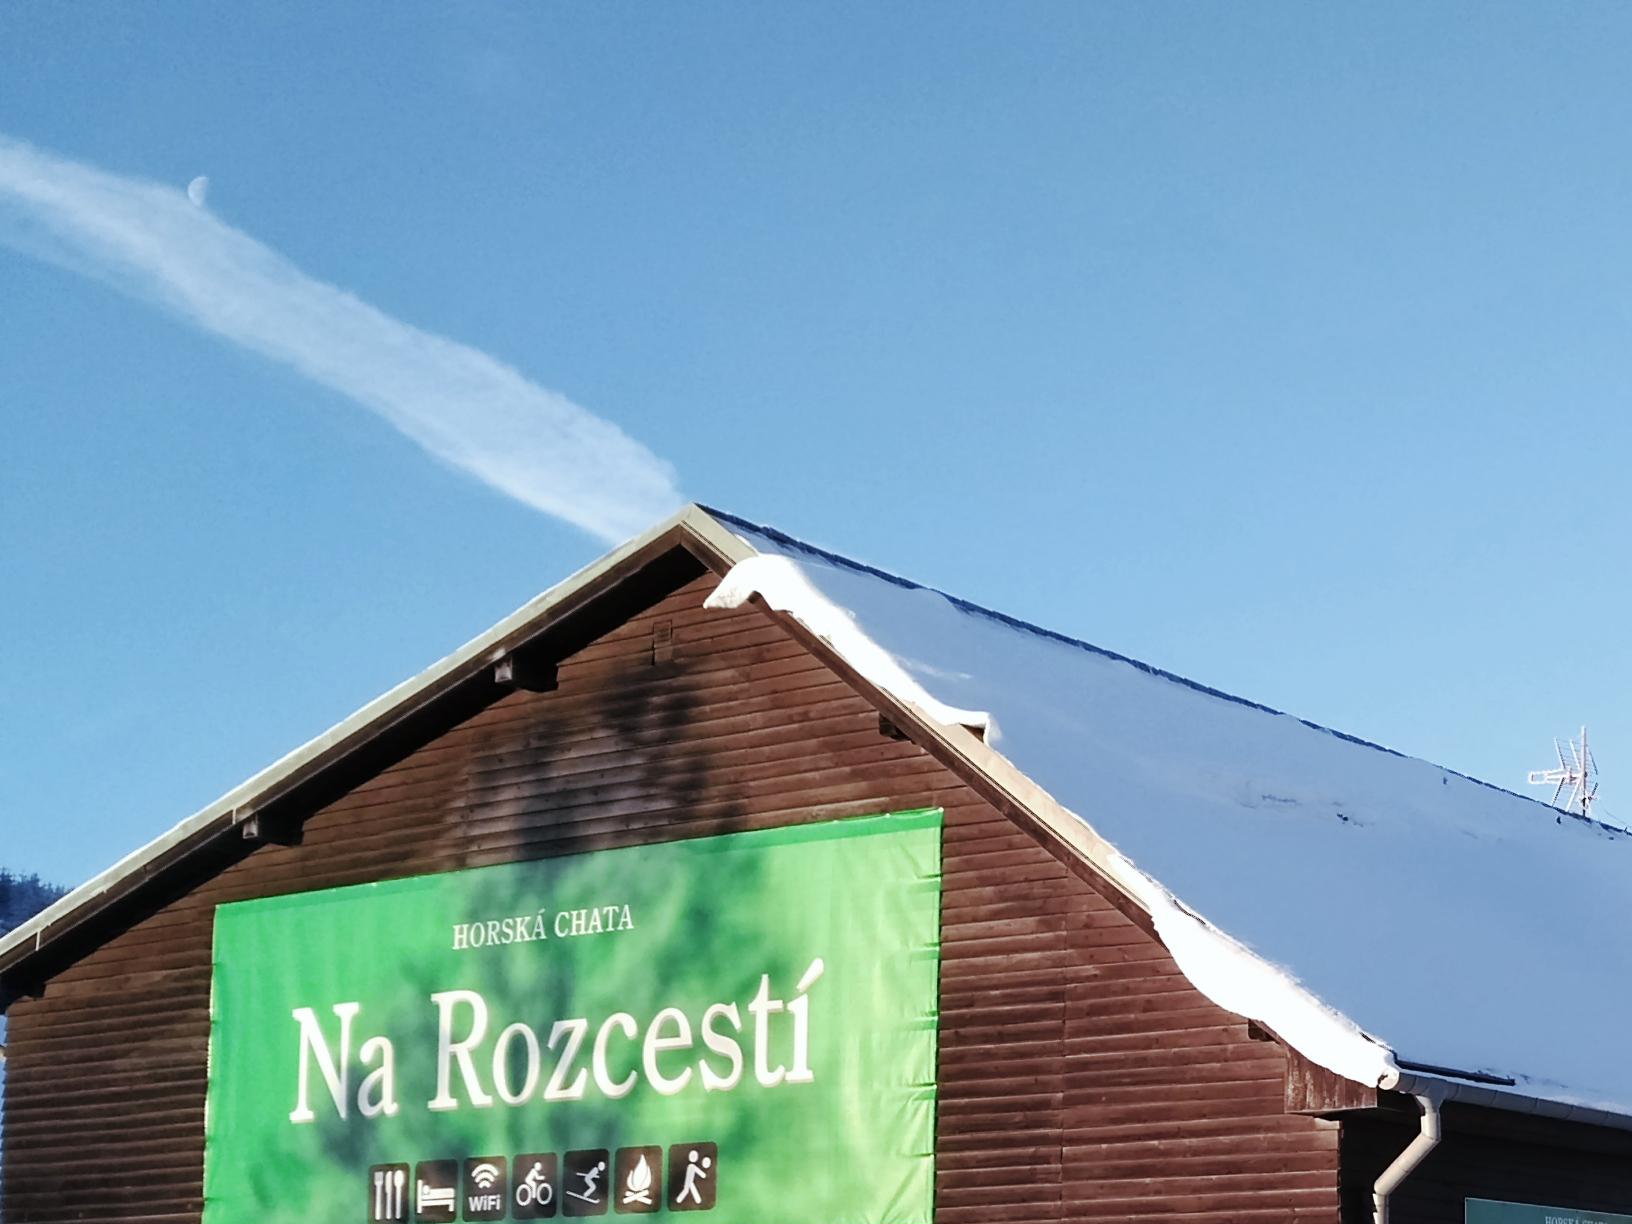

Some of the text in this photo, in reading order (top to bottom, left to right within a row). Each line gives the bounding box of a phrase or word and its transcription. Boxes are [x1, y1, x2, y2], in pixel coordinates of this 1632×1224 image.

[452, 904, 634, 950] HORSKÁ CHATA
[289, 957, 825, 1124] Na Rozcestí
[469, 1195, 500, 1212] WiFi
